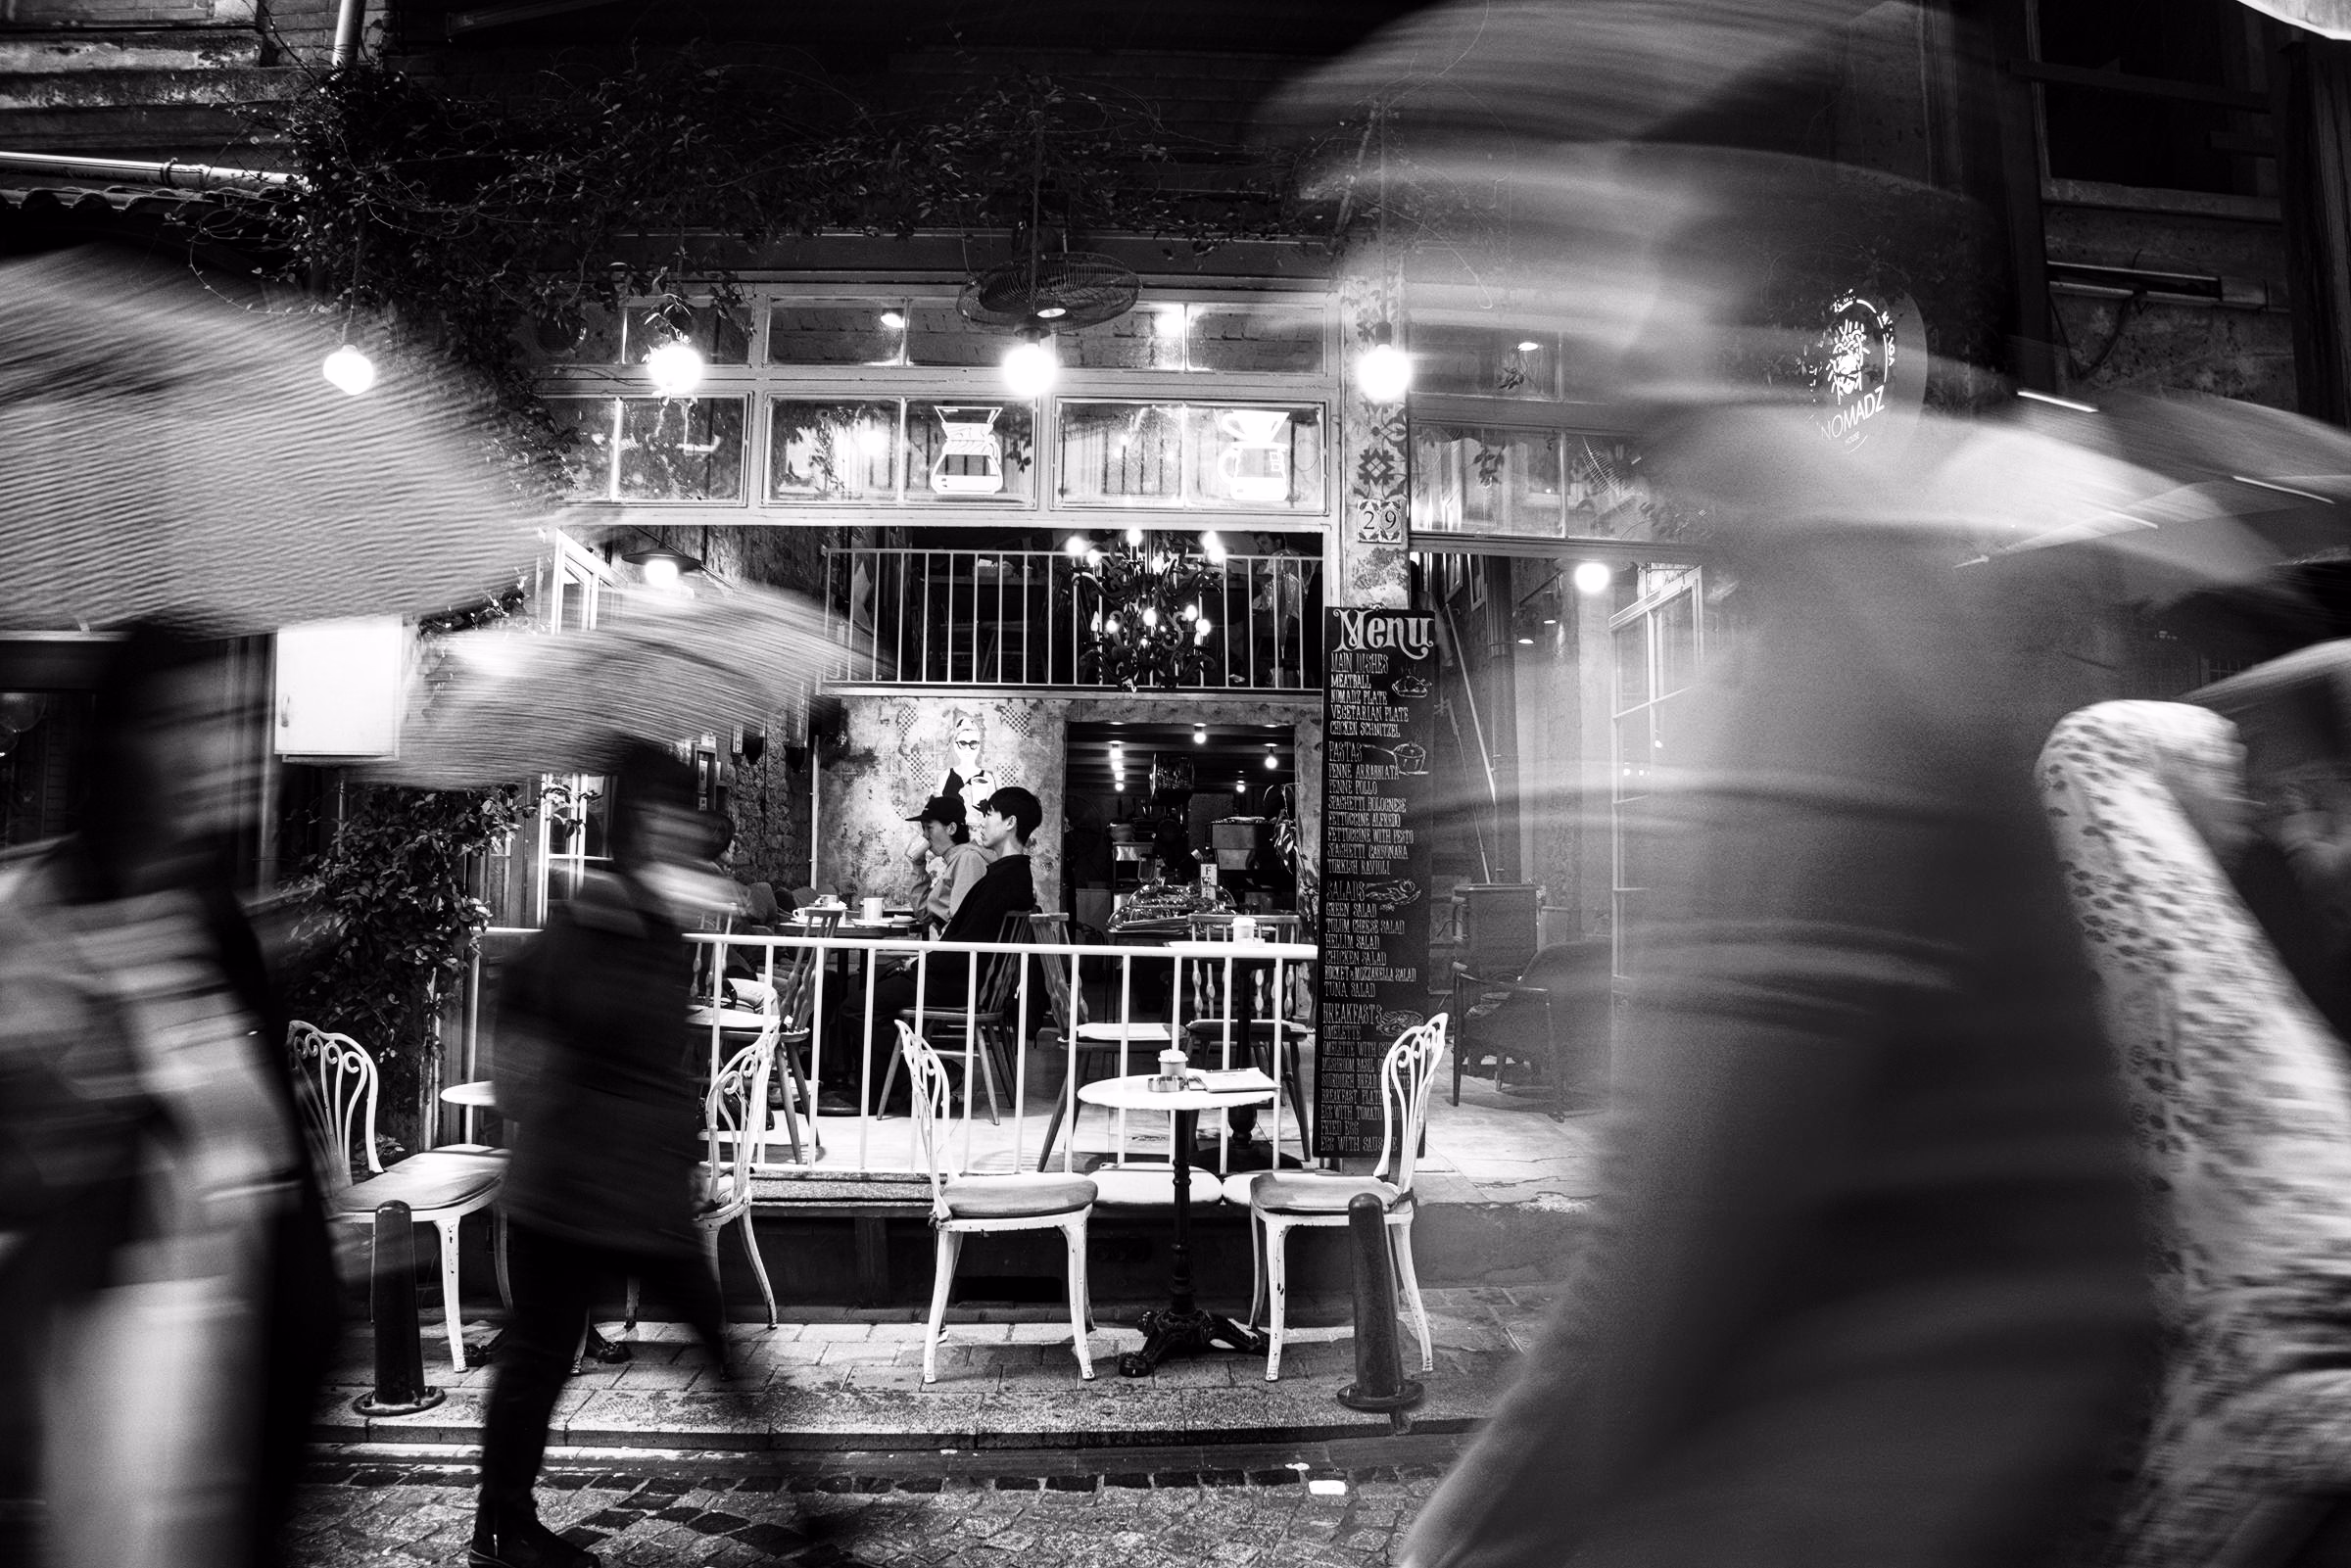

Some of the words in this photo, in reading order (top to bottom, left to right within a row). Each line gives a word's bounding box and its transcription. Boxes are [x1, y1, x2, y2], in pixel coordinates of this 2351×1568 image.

[1821, 385, 1885, 440] NOMADZ
[1364, 510, 1397, 529] 29
[1333, 608, 1434, 660] Menu
[1331, 652, 1352, 673] MAIN
[1356, 653, 1388, 674] DISHES
[1331, 674, 1371, 689] MEATBALL
[1330, 689, 1361, 704] NOMADZ
[1364, 690, 1387, 705] PLATE
[1330, 704, 1381, 721] VEGETARIAN
[1384, 706, 1409, 722] PLATE
[1330, 721, 1358, 736] CHICKEN
[1361, 722, 1401, 737] SCHNITZEL
[1328, 741, 1363, 762] PASTAS
[1329, 763, 1352, 779] PENNE
[1356, 764, 1400, 780] ARRABBIATA
[1329, 780, 1352, 794] PENNE
[1356, 781, 1377, 795] POLLO
[1328, 795, 1365, 811] SPAGHETTI
[1367, 797, 1407, 813] BOLOGNESE
[1328, 811, 1370, 826] FETTUCCINE
[1372, 813, 1401, 827] ALFREDO
[1327, 827, 1370, 842] FETTUCCINE
[1372, 829, 1391, 843] WITH
[1393, 830, 1414, 844] PESTO
[1327, 842, 1366, 859] SPAGHETTI
[1368, 844, 1409, 859] CARBONARA
[1327, 859, 1358, 874] TURKISH
[1361, 860, 1390, 875] RAVIOLI
[1326, 880, 1366, 901] SALADS
[1326, 902, 1349, 917] GREEN
[1353, 903, 1377, 918] SALAD
[1325, 918, 1350, 933] TULUM
[1352, 919, 1379, 934] CHEESE
[1380, 920, 1405, 934] SALAD
[1325, 933, 1354, 949] HELLIM
[1356, 934, 1380, 950] SALAD
[1325, 950, 1360, 965] CHICKEN
[1362, 951, 1387, 966] SALAD
[1324, 965, 1349, 980] ROCKET
[1395, 968, 1416, 982] SALAD
[1324, 981, 1348, 997] TUNA
[1351, 982, 1376, 997] SALAD
[1322, 1003, 1383, 1024] BREAKFASTS
[1322, 1024, 1361, 1040] OMELETTE
[1323, 1040, 1355, 1057] OMELETTE
[1358, 1041, 1376, 1057] WITH
[1321, 1088, 1358, 1104] BREAKFAST
[1320, 1104, 1333, 1119] EGG
[1334, 1104, 1352, 1120] WITH
[1356, 1106, 1383, 1120] TOMATO
[1320, 1120, 1342, 1135] FRIED
[1345, 1120, 1360, 1135] EGG
[1320, 1136, 1334, 1151] EGG
[1338, 1136, 1360, 1152] WITH
[1363, 1136, 1398, 1152] SAUSE
